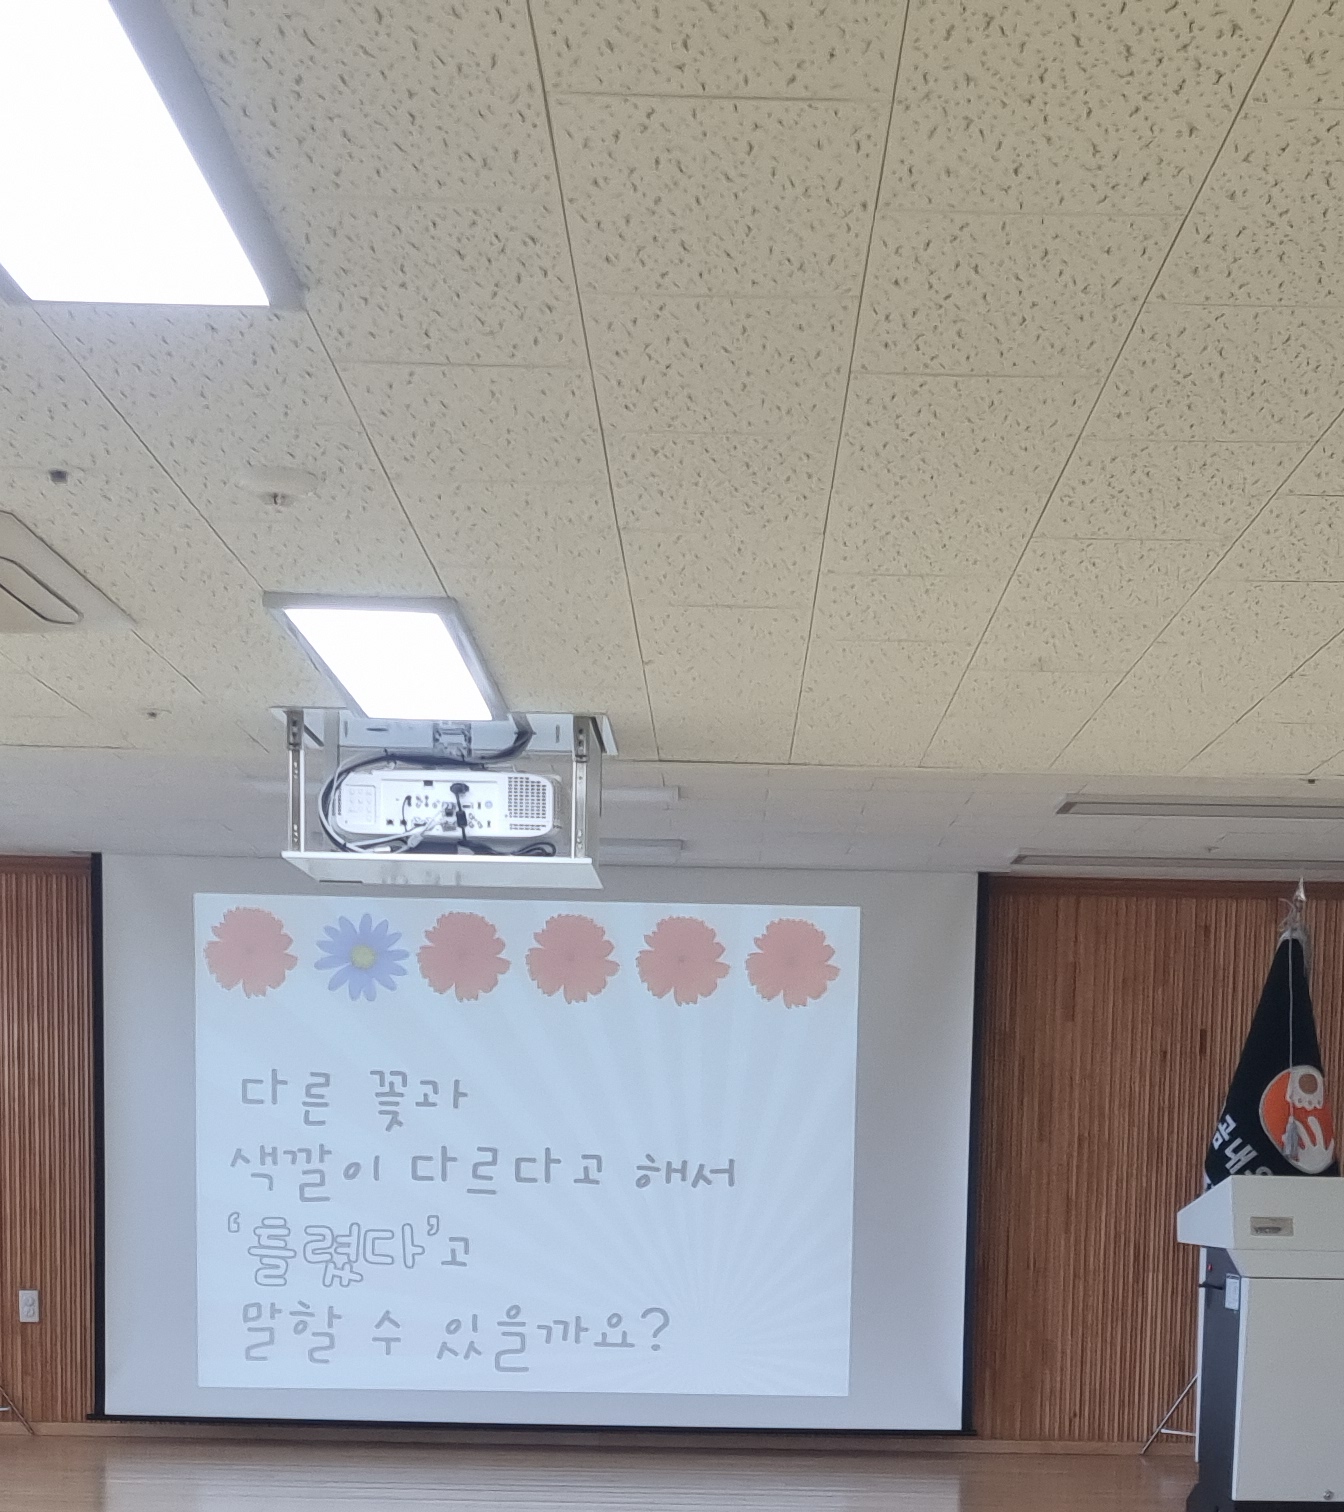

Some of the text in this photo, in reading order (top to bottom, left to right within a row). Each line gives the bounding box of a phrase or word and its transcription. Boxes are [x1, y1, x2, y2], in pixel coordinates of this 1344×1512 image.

[241, 1069, 469, 1131] 다른 꽃과
[230, 1143, 736, 1202] 색깔이 다르다고 해서
[242, 1300, 671, 1373] 말할 수 있을까요?
